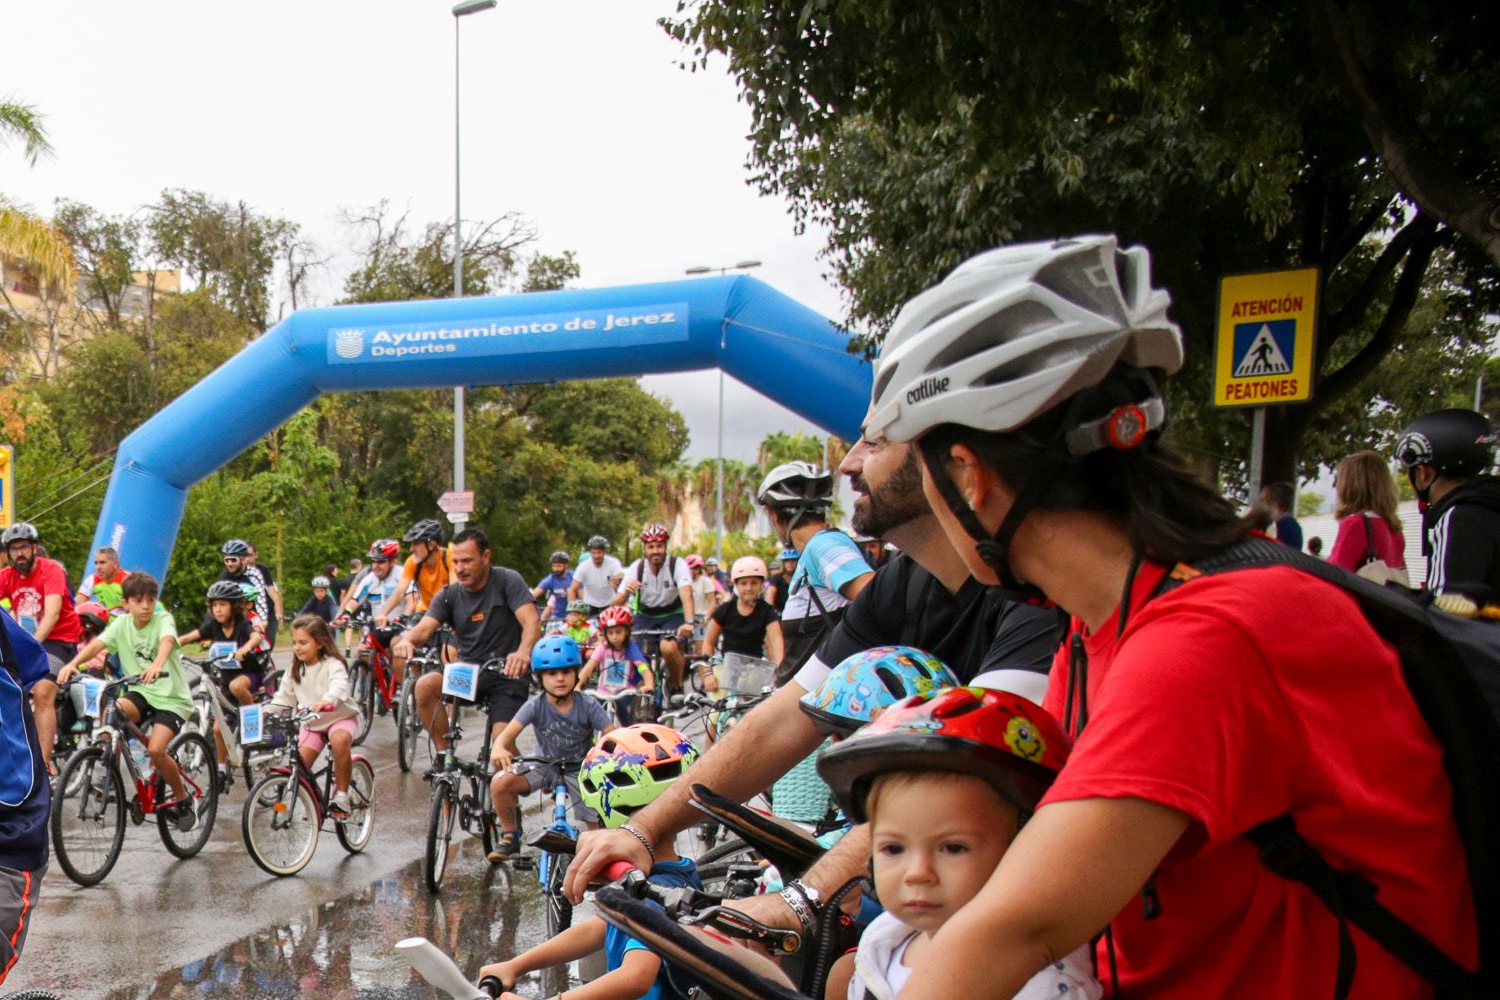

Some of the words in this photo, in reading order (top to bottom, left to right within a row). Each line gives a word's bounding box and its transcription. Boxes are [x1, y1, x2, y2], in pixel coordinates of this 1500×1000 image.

[1231, 294, 1303, 317] ATENCIÓN
[372, 320, 557, 346] Ayuntamiento
[564, 317, 596, 331] de
[604, 311, 676, 331] Jerez
[372, 343, 457, 357] Deportes
[906, 377, 949, 405] catlike
[1226, 380, 1297, 400] PEATONES
